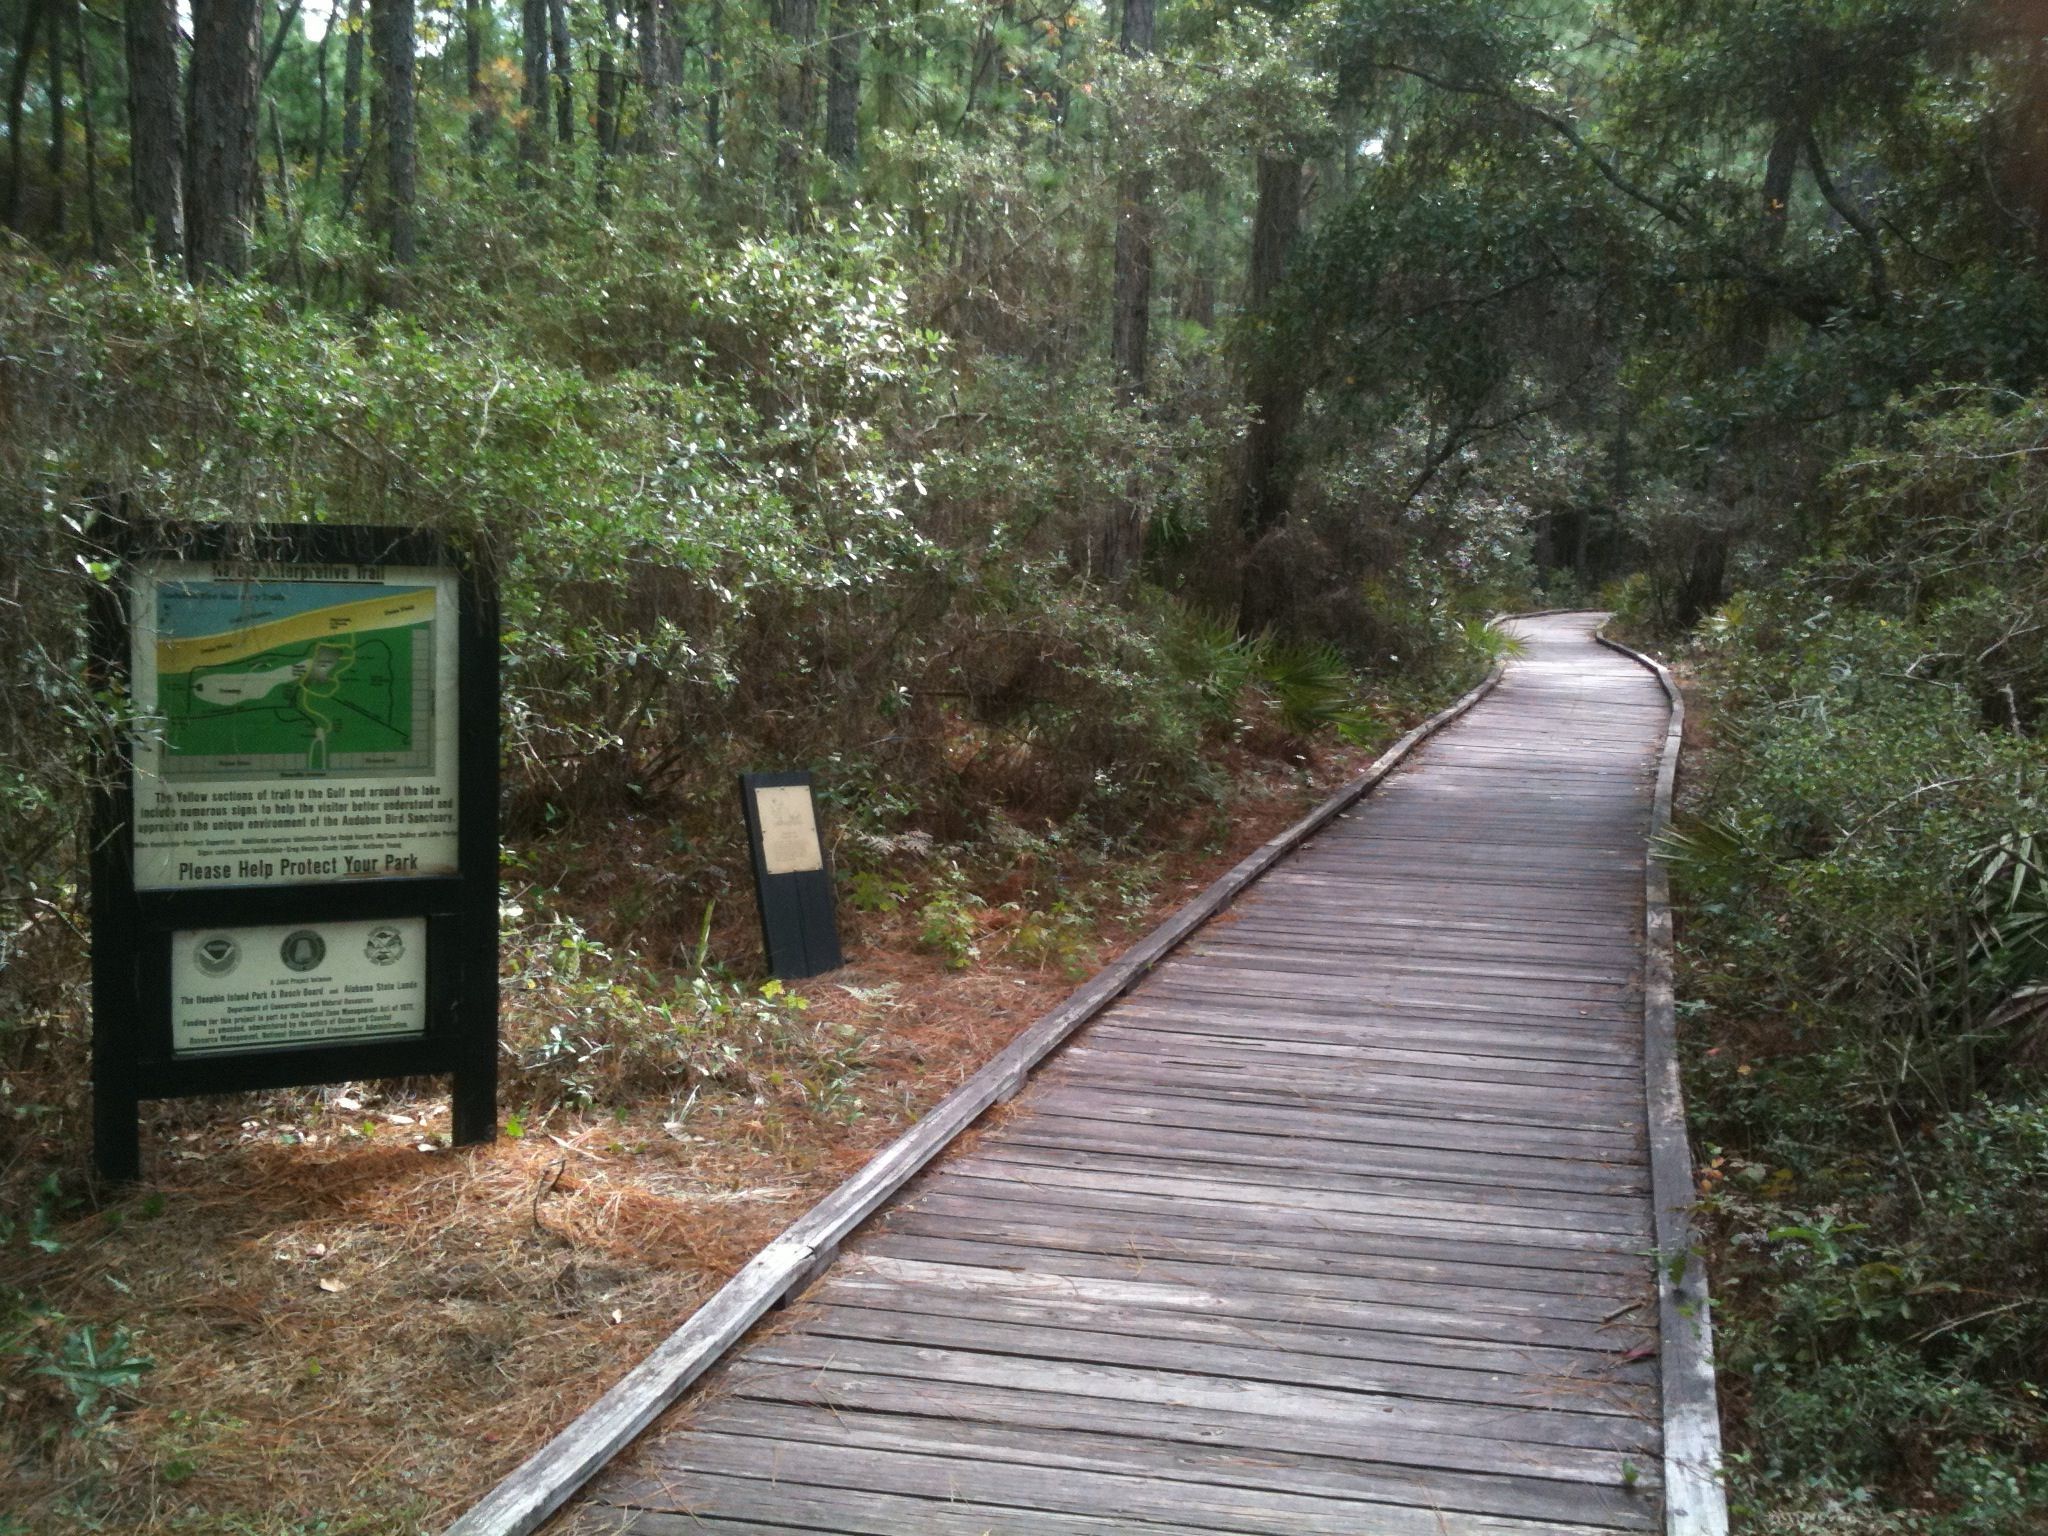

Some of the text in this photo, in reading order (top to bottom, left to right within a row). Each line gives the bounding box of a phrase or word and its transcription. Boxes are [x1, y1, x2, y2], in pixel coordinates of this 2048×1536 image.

[356, 564, 384, 580] Trail
[155, 785, 440, 803] The Yellow sections of trail to the Gulf and around the lake
[180, 806, 228, 817] numerous
[231, 805, 257, 817] signs
[262, 804, 272, 814] to
[275, 804, 295, 815] help
[299, 803, 314, 813] the
[318, 802, 348, 812] visitor
[352, 801, 380, 812] better
[383, 799, 434, 810] understand
[437, 798, 453, 809] and
[138, 813, 456, 834] appreciate the unique environment of the Audubon Bird Sanctuary.
[179, 853, 418, 880] Please Help Protect Your Park
[227, 993, 249, 1001] Island
[252, 991, 267, 999] Park
[271, 990, 276, 998] &
[303, 988, 323, 996] Board
[344, 984, 373, 993] Alabama
[376, 983, 394, 991] State
